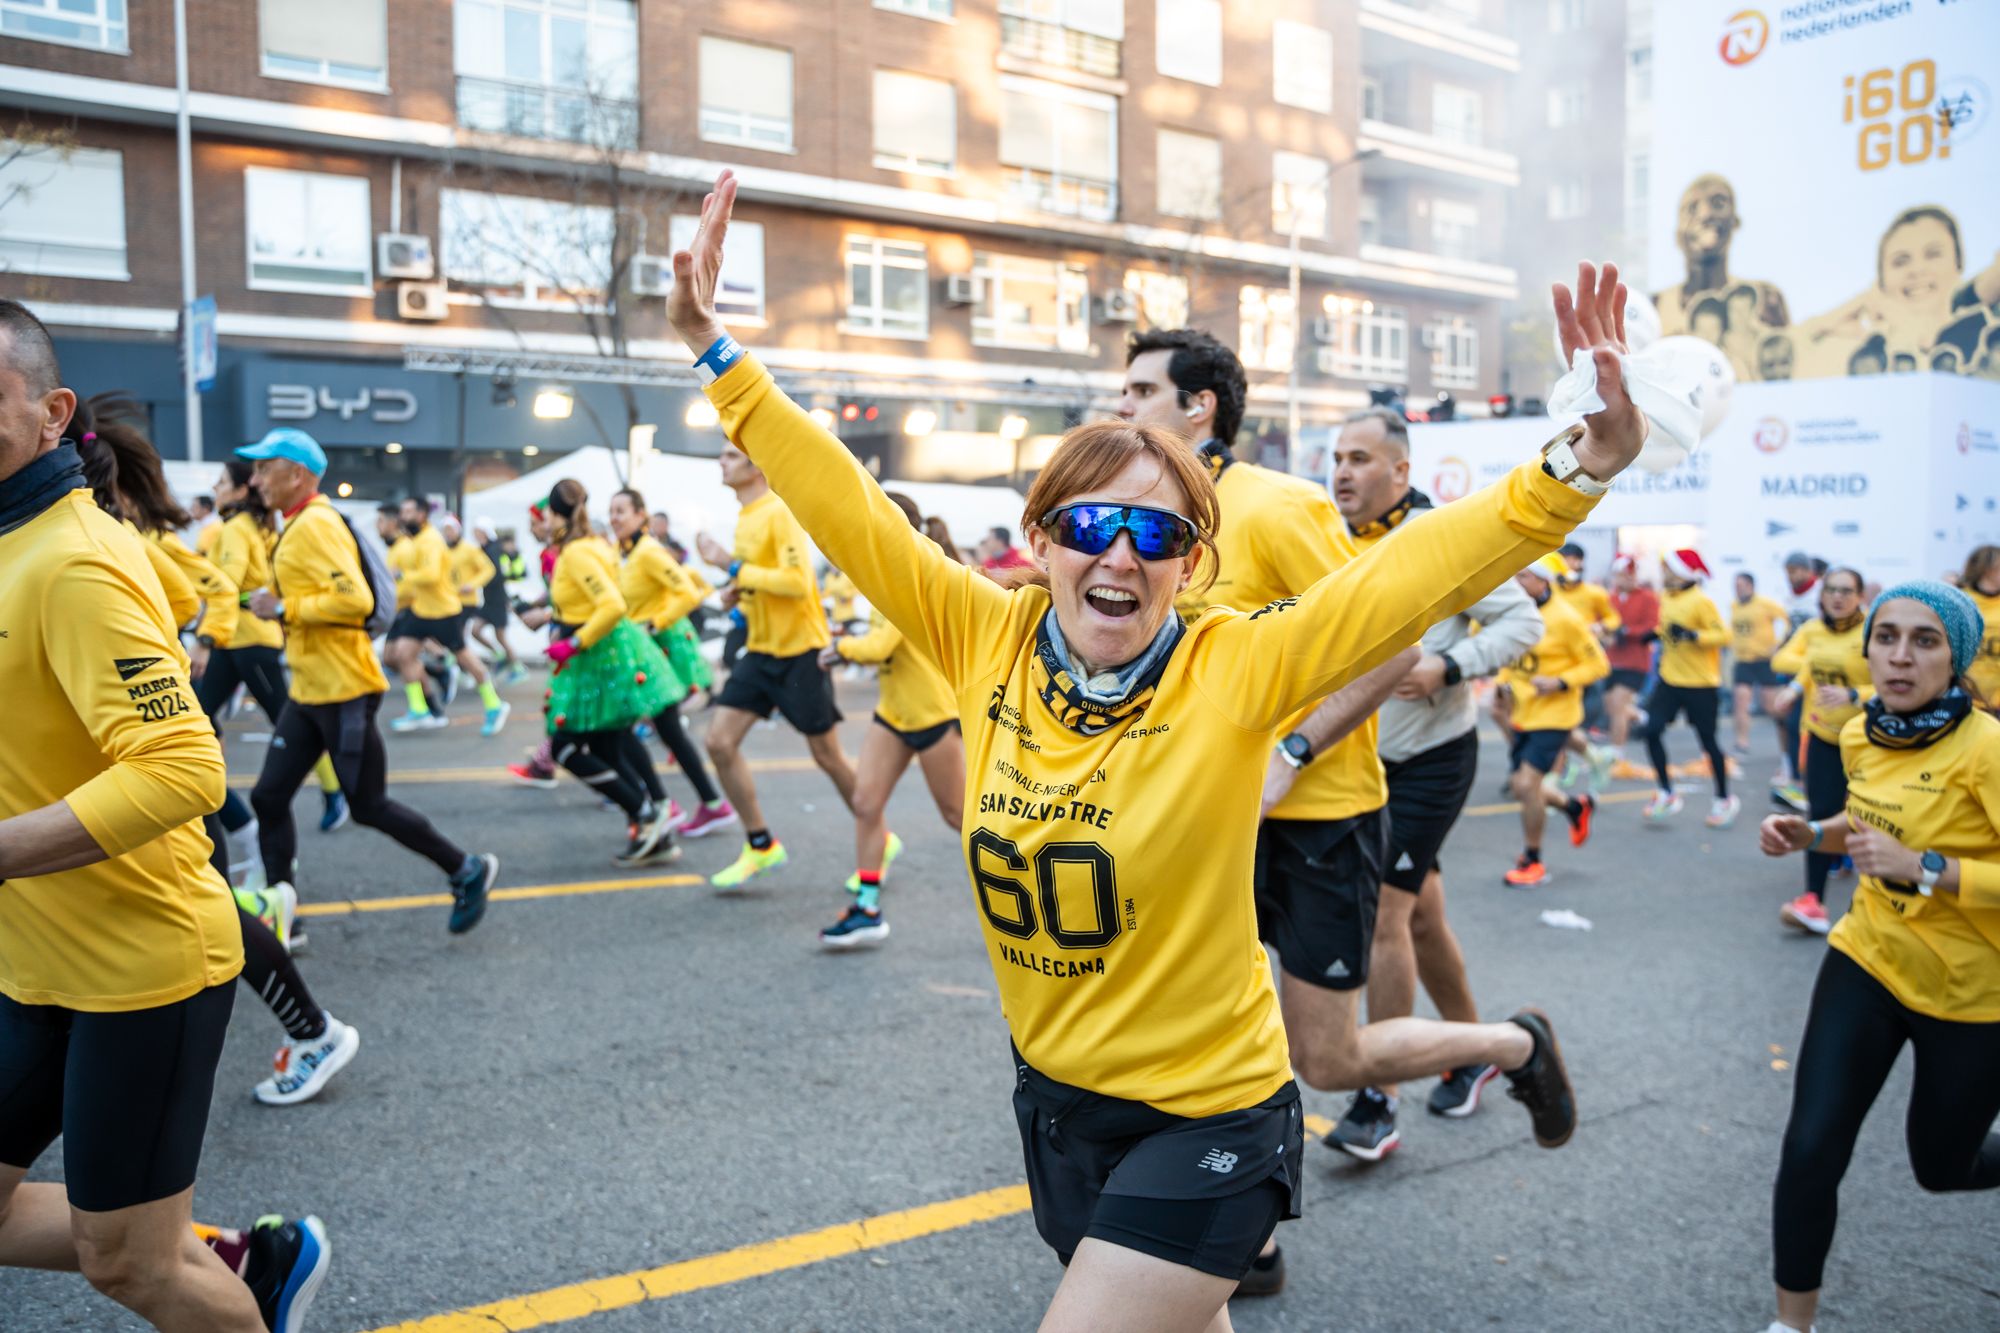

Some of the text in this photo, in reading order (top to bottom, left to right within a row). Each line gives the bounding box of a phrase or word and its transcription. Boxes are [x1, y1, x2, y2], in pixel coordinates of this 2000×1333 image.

[1781, 0, 1912, 43] nederlanden
[268, 384, 418, 421] BYD
[1760, 473, 1868, 497] MADRID
[127, 676, 179, 701] MARCA
[136, 691, 190, 723] 2024
[1120, 723, 1170, 740] MERANG
[980, 793, 1114, 831] SAN SILVTRE
[968, 825, 1123, 951] 60
[998, 942, 1106, 978] VALLECANA
